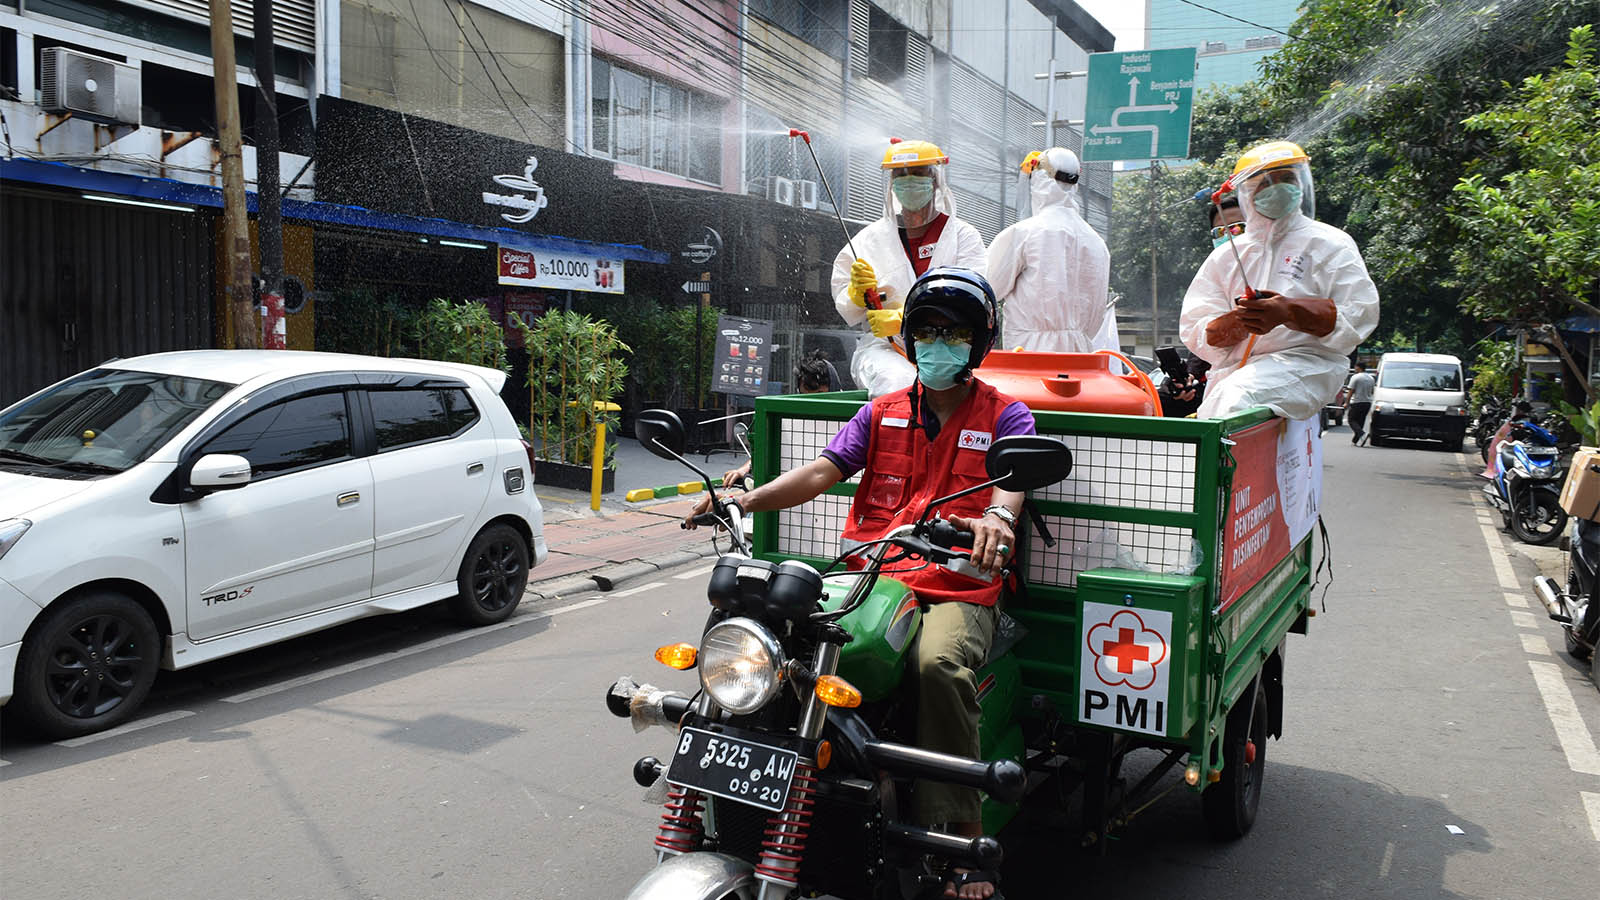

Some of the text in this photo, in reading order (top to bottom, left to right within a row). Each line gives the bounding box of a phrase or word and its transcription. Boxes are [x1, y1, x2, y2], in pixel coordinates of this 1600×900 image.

[1122, 53, 1151, 63] Industri
[1120, 63, 1152, 76] Rajawali
[1165, 91, 1180, 101] PRJ
[1084, 135, 1122, 146] Pasar Baru
[503, 251, 530, 264] Special
[510, 262, 529, 275] Offer
[975, 436, 990, 446] PMI
[1235, 485, 1250, 514] UNIT
[202, 590, 238, 606] TRD
[1084, 688, 1164, 732] PMI
[679, 732, 793, 780] B 5325 AW
